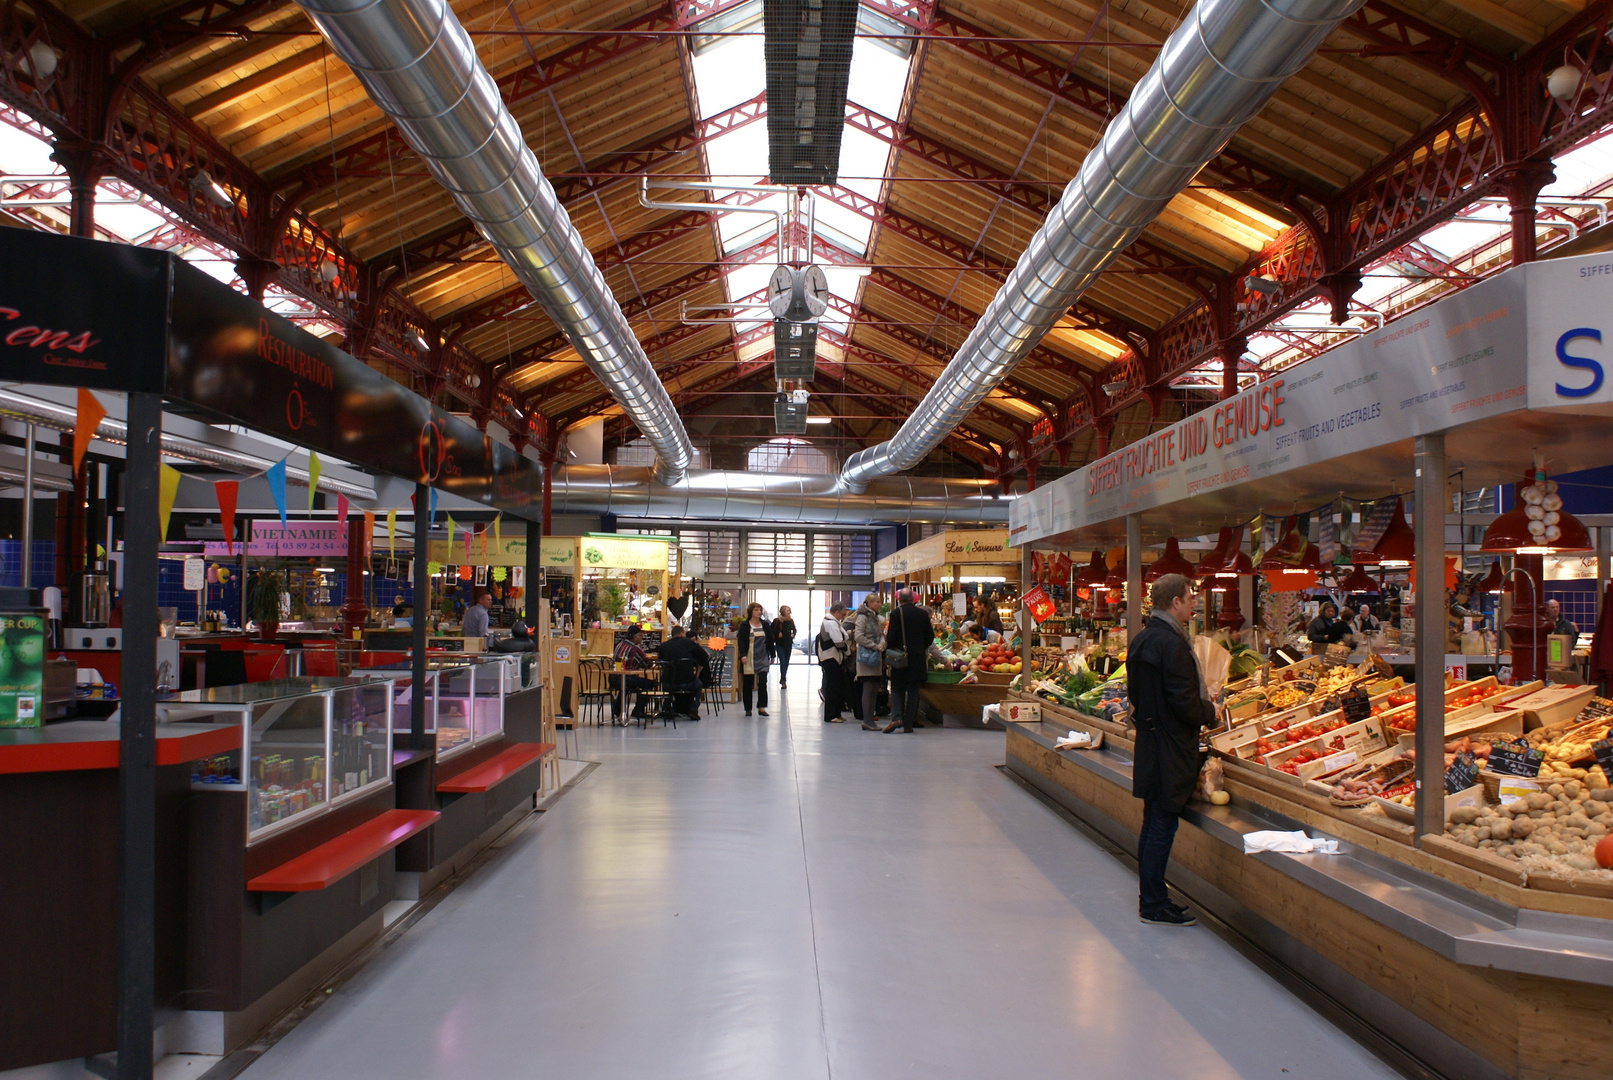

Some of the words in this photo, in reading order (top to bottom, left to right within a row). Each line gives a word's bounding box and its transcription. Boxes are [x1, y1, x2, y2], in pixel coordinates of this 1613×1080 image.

[1580, 265, 1613, 277] SIFFE
[1555, 327, 1605, 398] S
[1299, 423, 1319, 443] FRUITS
[1321, 418, 1335, 436] AND
[1336, 402, 1381, 430] VEGETABLES
[1089, 452, 1123, 496] SIFFERT
[1125, 429, 1175, 482] FRUCHTE
[1178, 415, 1208, 462] UND
[1212, 379, 1285, 449] GEMUSE
[946, 541, 964, 553] Les
[971, 541, 1003, 553] Saveurs
[17, 620, 37, 629] CUP
